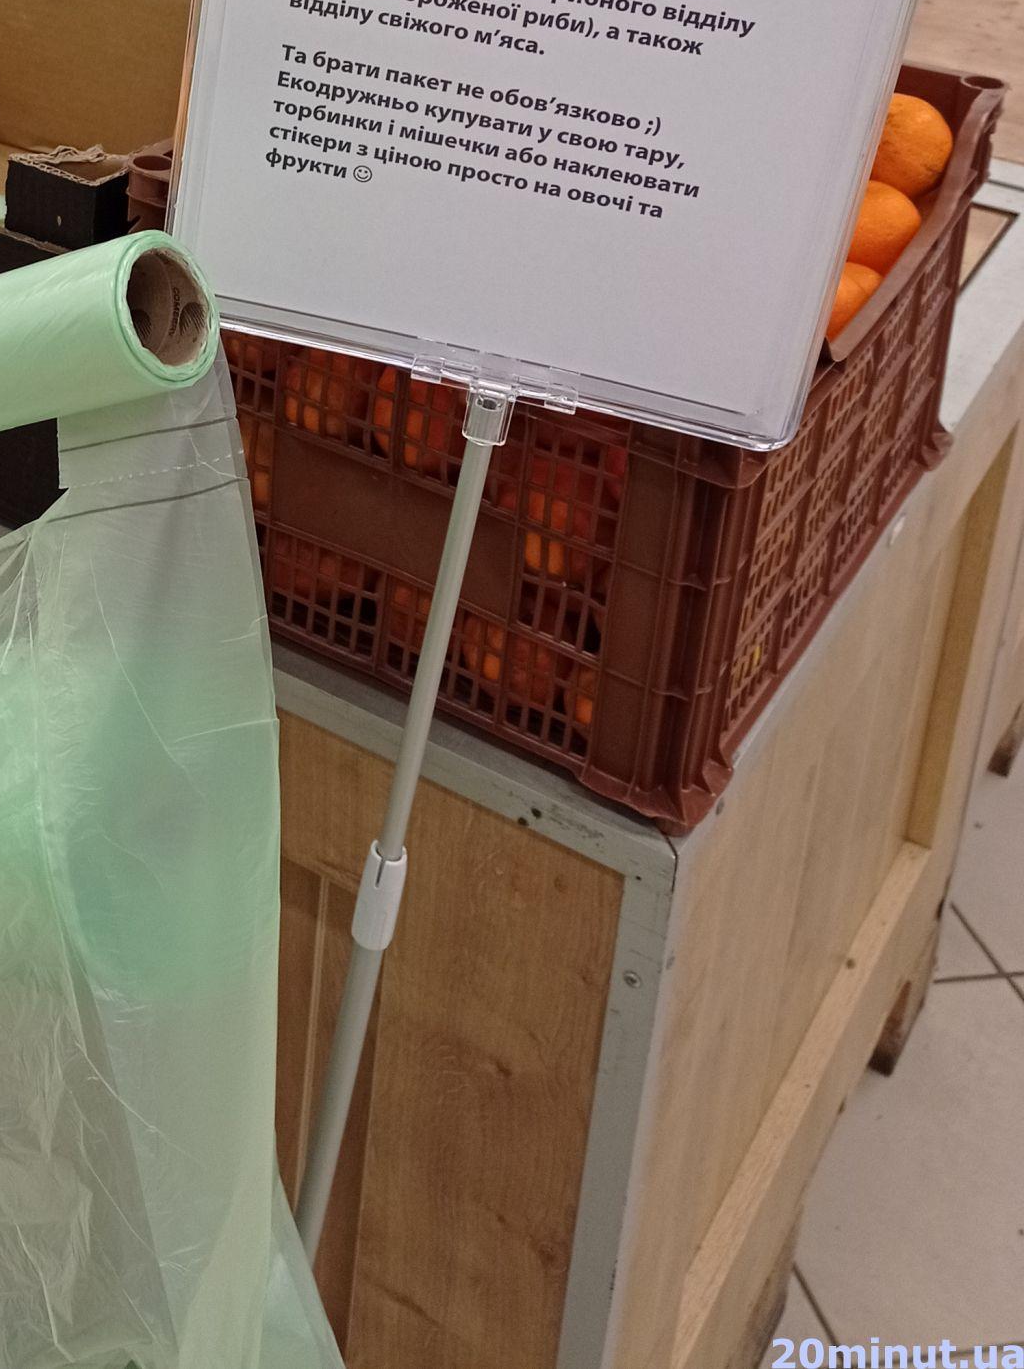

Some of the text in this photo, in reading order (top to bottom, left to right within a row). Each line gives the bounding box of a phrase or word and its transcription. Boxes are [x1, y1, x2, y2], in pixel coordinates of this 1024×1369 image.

[377, 11, 469, 40] свіжого
[521, 9, 601, 40] риби),
[605, 25, 621, 41] а
[625, 28, 705, 56] також
[662, 3, 756, 39] відділу
[276, 69, 685, 170] Екодружньо купувати у свою тару,
[281, 43, 307, 65] Та
[312, 50, 381, 80] брати
[384, 68, 453, 93] пакет
[456, 82, 485, 100] не
[643, 116, 662, 137] ;)
[265, 147, 348, 179] фрукти
[268, 125, 664, 219] стікери з ціною просто на овочі та
[272, 99, 700, 199] торбинки і мішечки або наклеювати
